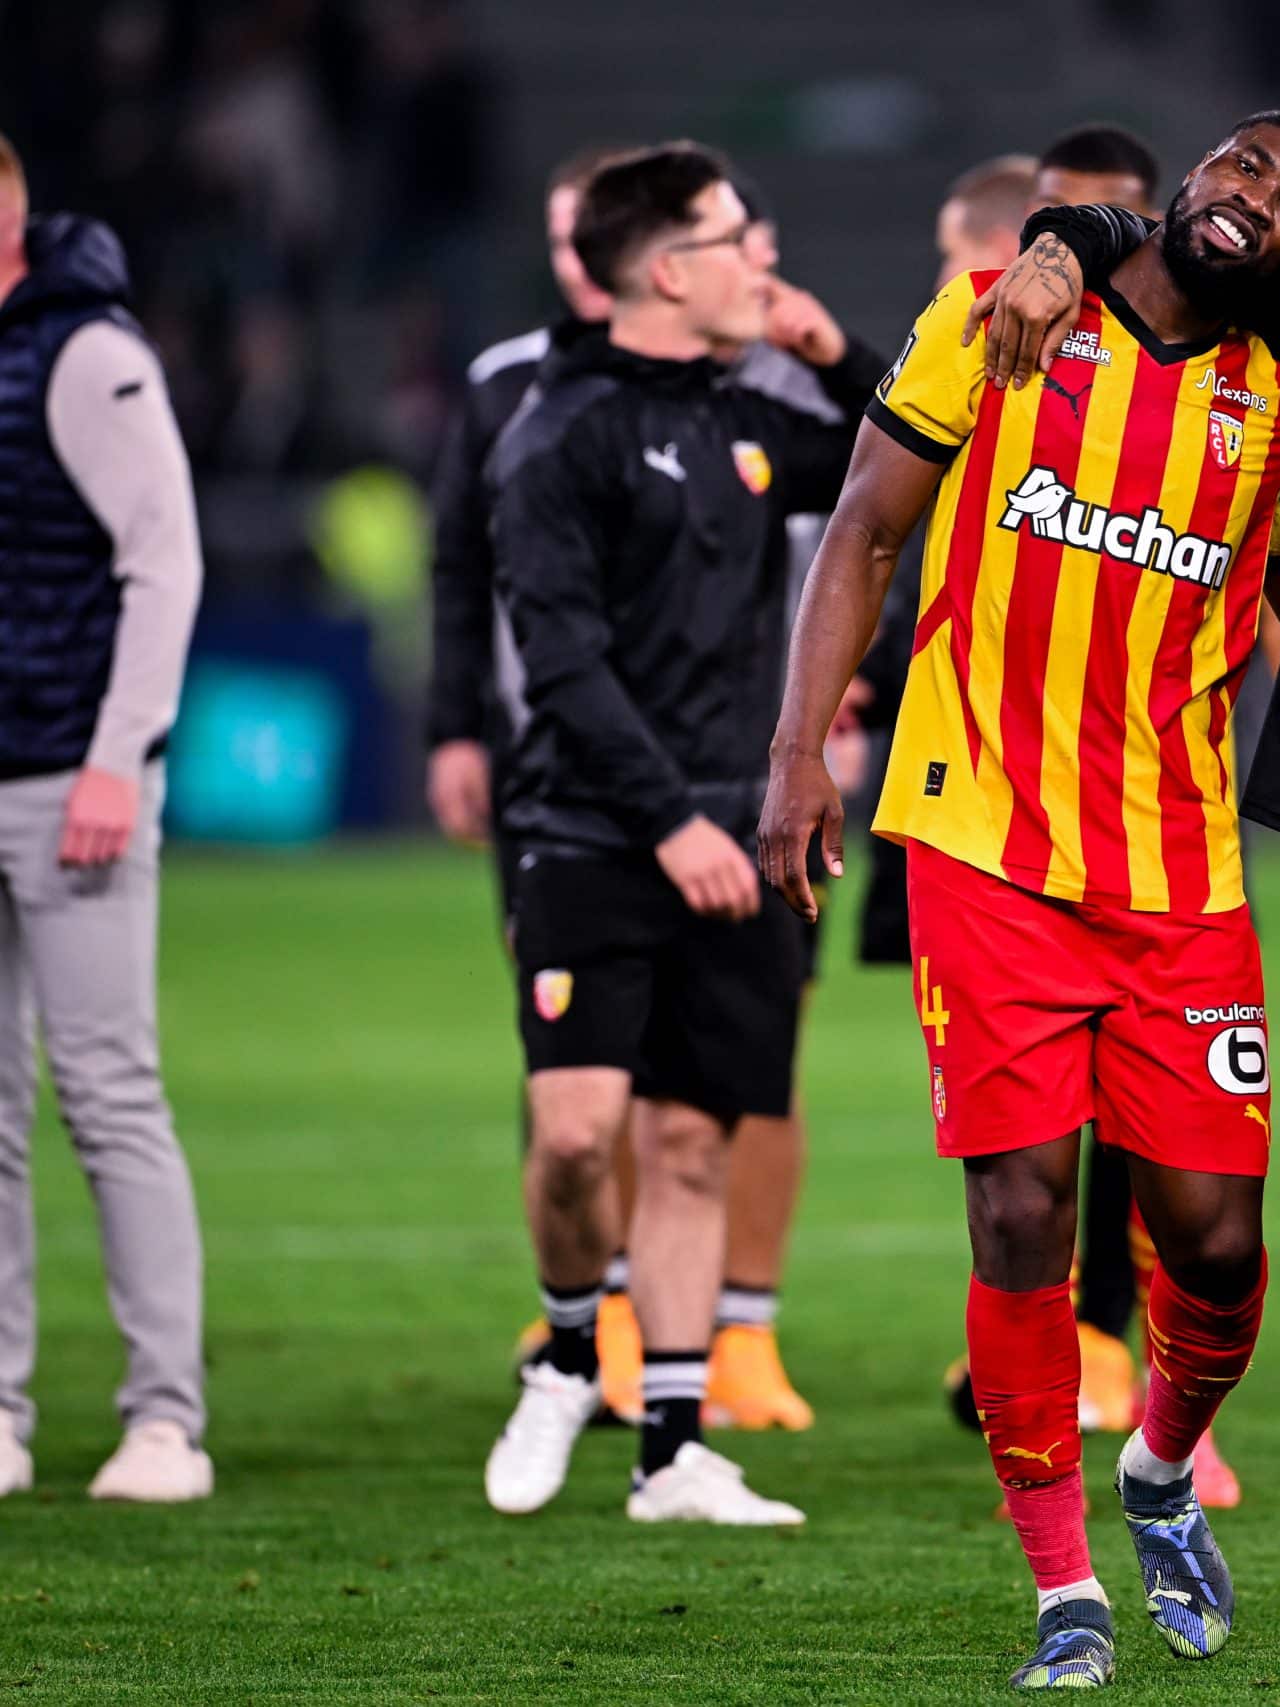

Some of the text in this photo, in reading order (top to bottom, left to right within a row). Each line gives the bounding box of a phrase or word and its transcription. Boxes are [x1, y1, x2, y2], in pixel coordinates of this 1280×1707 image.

[1061, 339, 1112, 363] EREUR
[1068, 329, 1099, 347] UPE
[1196, 368, 1267, 413] Nexans
[1211, 422, 1226, 465] RCL
[999, 466, 1232, 589] Auchan
[920, 956, 950, 1046] 4
